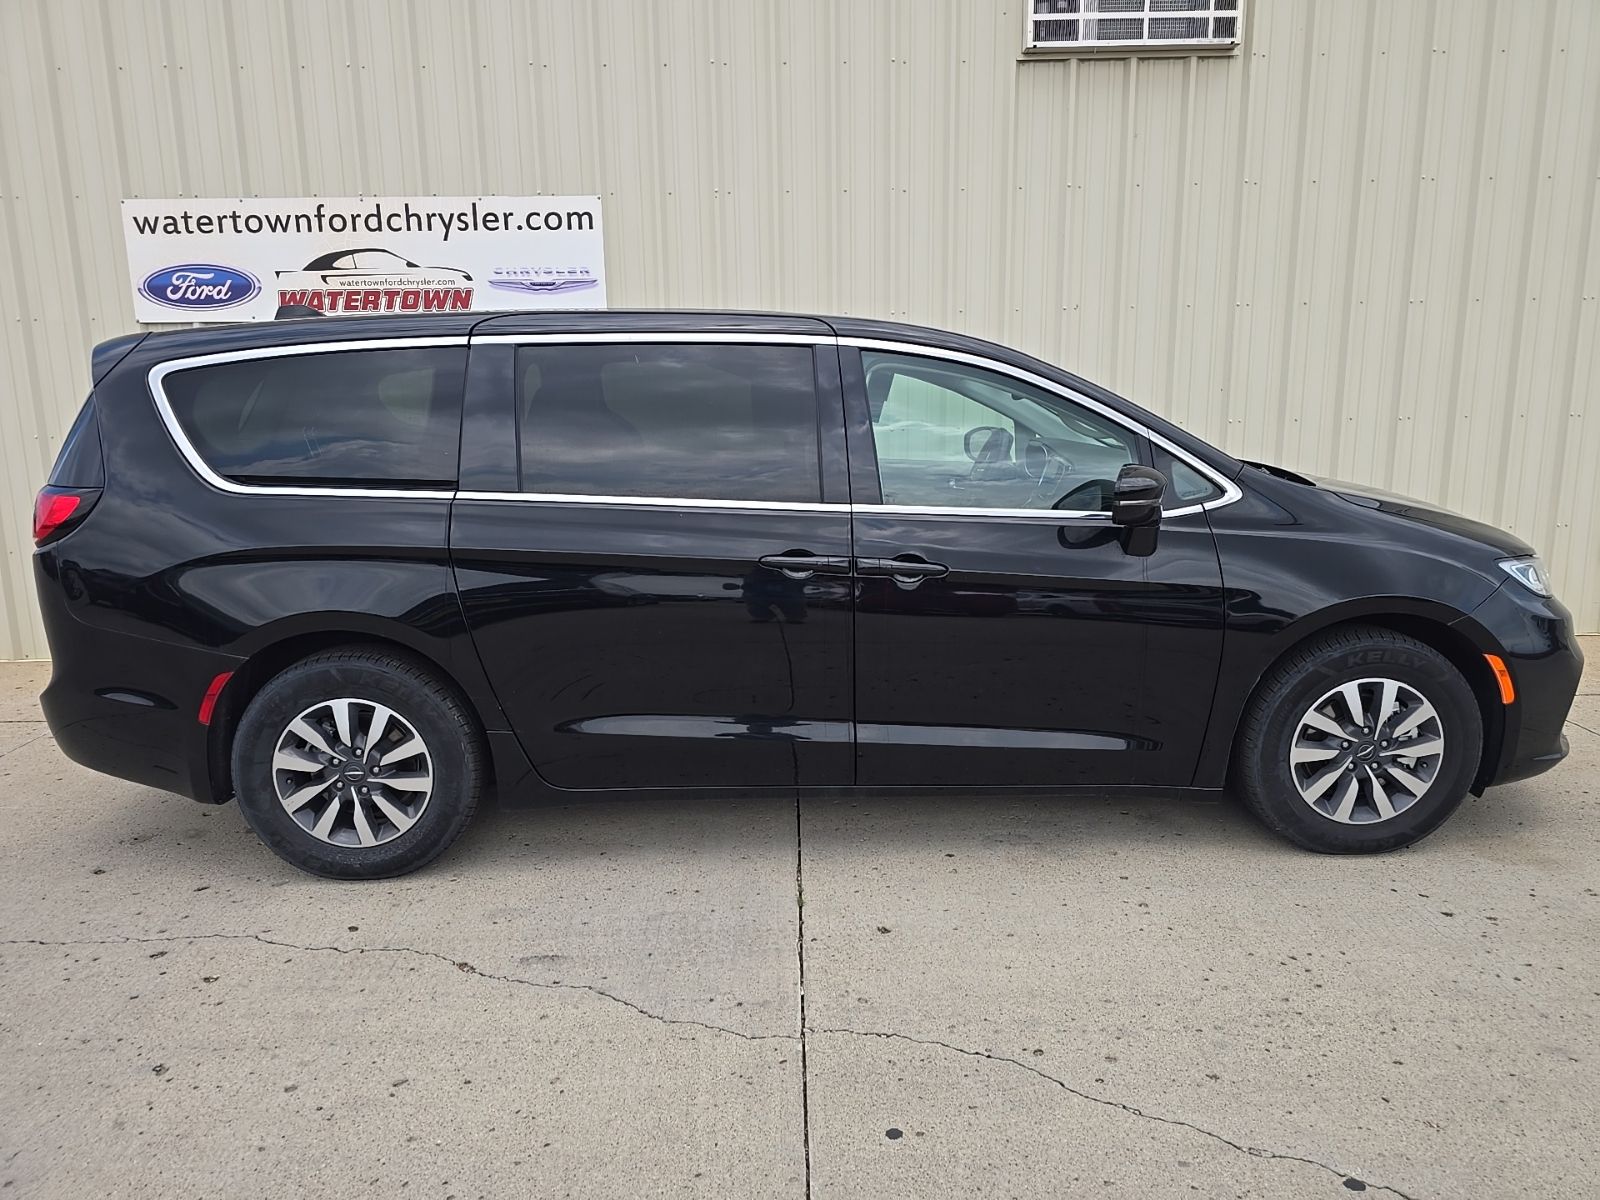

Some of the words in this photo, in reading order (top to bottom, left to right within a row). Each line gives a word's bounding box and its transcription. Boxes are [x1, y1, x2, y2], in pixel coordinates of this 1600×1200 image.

[132, 202, 594, 241] watertownfordchrysler.com
[166, 271, 232, 300] Ford
[339, 277, 456, 288] watertownfordchrysler.com
[278, 288, 473, 312] WATERTOWN
[1345, 650, 1427, 669] KELLY
